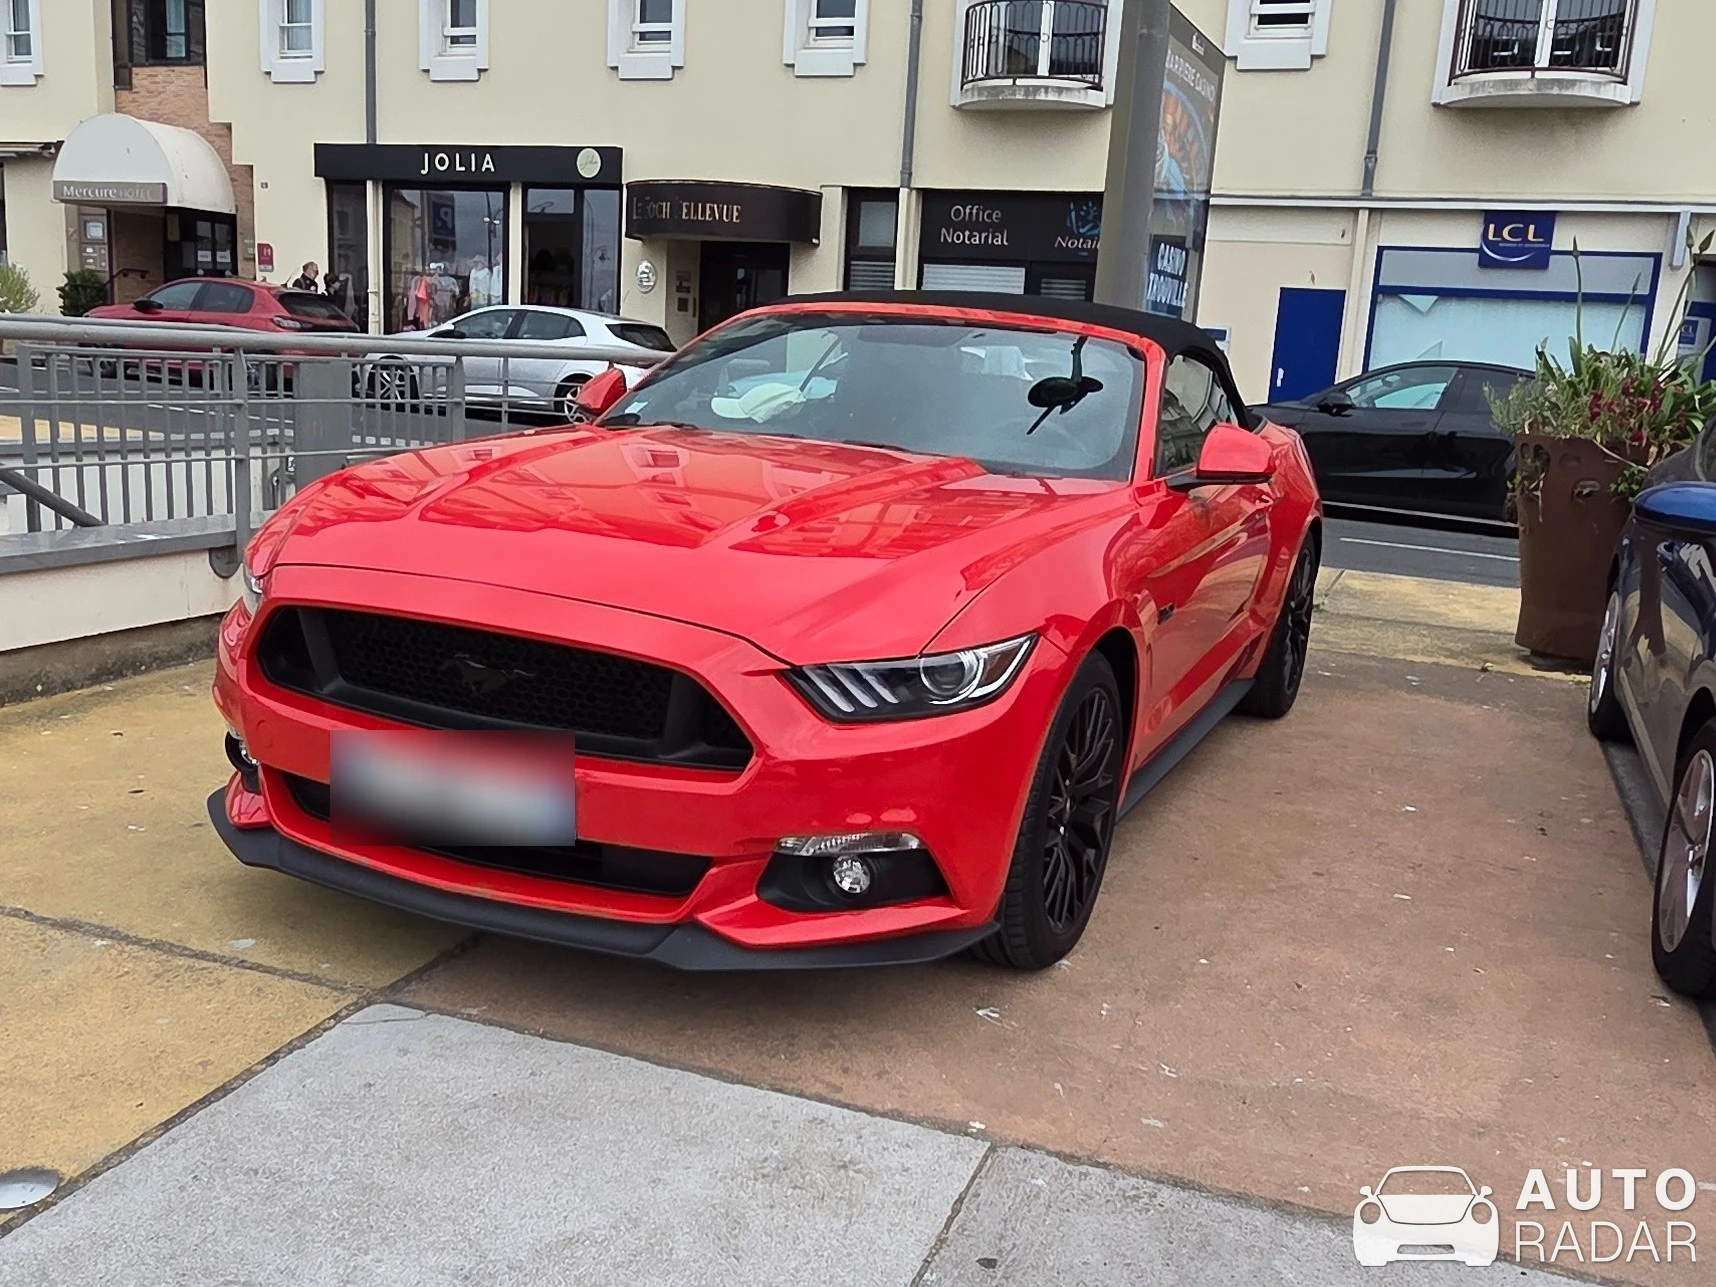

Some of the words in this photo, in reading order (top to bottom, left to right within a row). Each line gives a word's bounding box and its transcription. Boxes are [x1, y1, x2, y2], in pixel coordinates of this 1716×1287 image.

[421, 153, 495, 175] JOLIA
[63, 185, 118, 198] Mercure
[119, 188, 152, 200] HOTEL
[676, 200, 742, 224] ELLEVUE
[950, 205, 1002, 223] Office
[940, 227, 1009, 246] Notarial
[1487, 223, 1545, 242] LCL
[1157, 242, 1186, 277] CASINO
